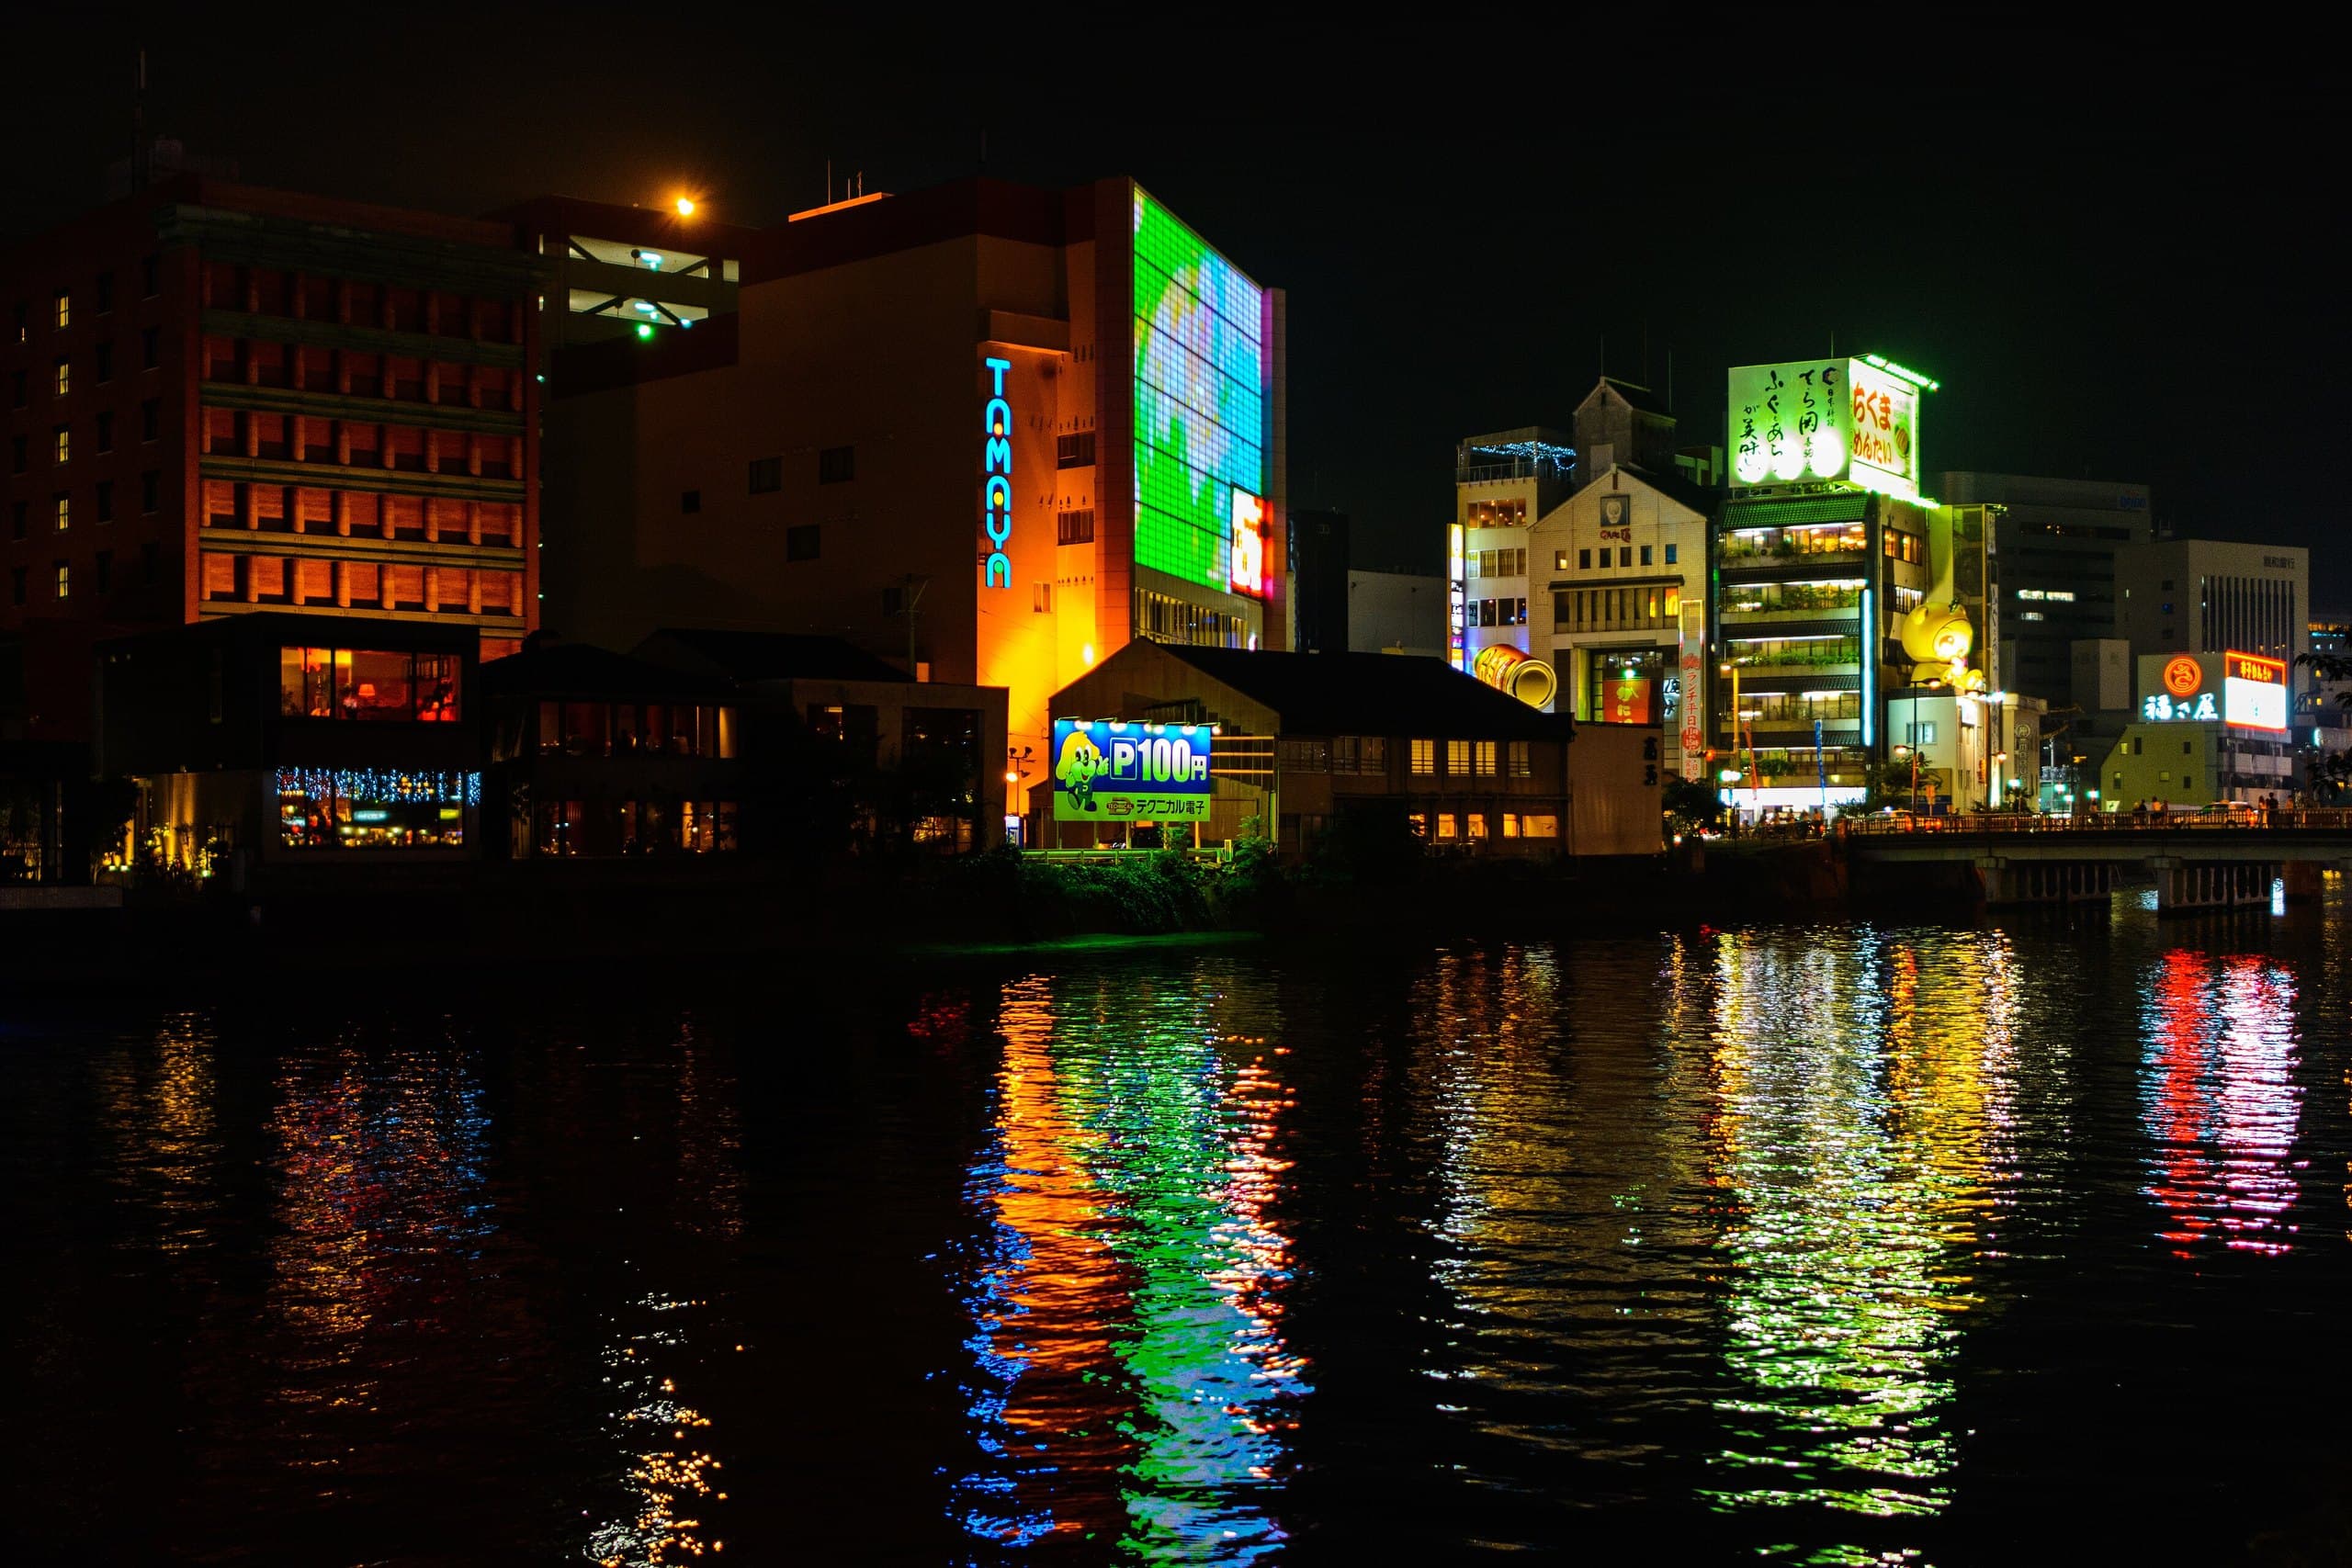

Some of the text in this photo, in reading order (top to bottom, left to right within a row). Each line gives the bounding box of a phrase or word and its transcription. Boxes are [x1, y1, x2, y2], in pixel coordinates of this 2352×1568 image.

[1798, 368, 1819, 435] てら岡
[1852, 428, 1893, 465] めんたい
[986, 357, 1012, 589] TAMAYA
[1686, 671, 1699, 726] ランチ平日
[2144, 692, 2220, 721] 福さ屋
[1114, 738, 1207, 783] P 100円
[1136, 798, 1205, 816] テクニカル電子
